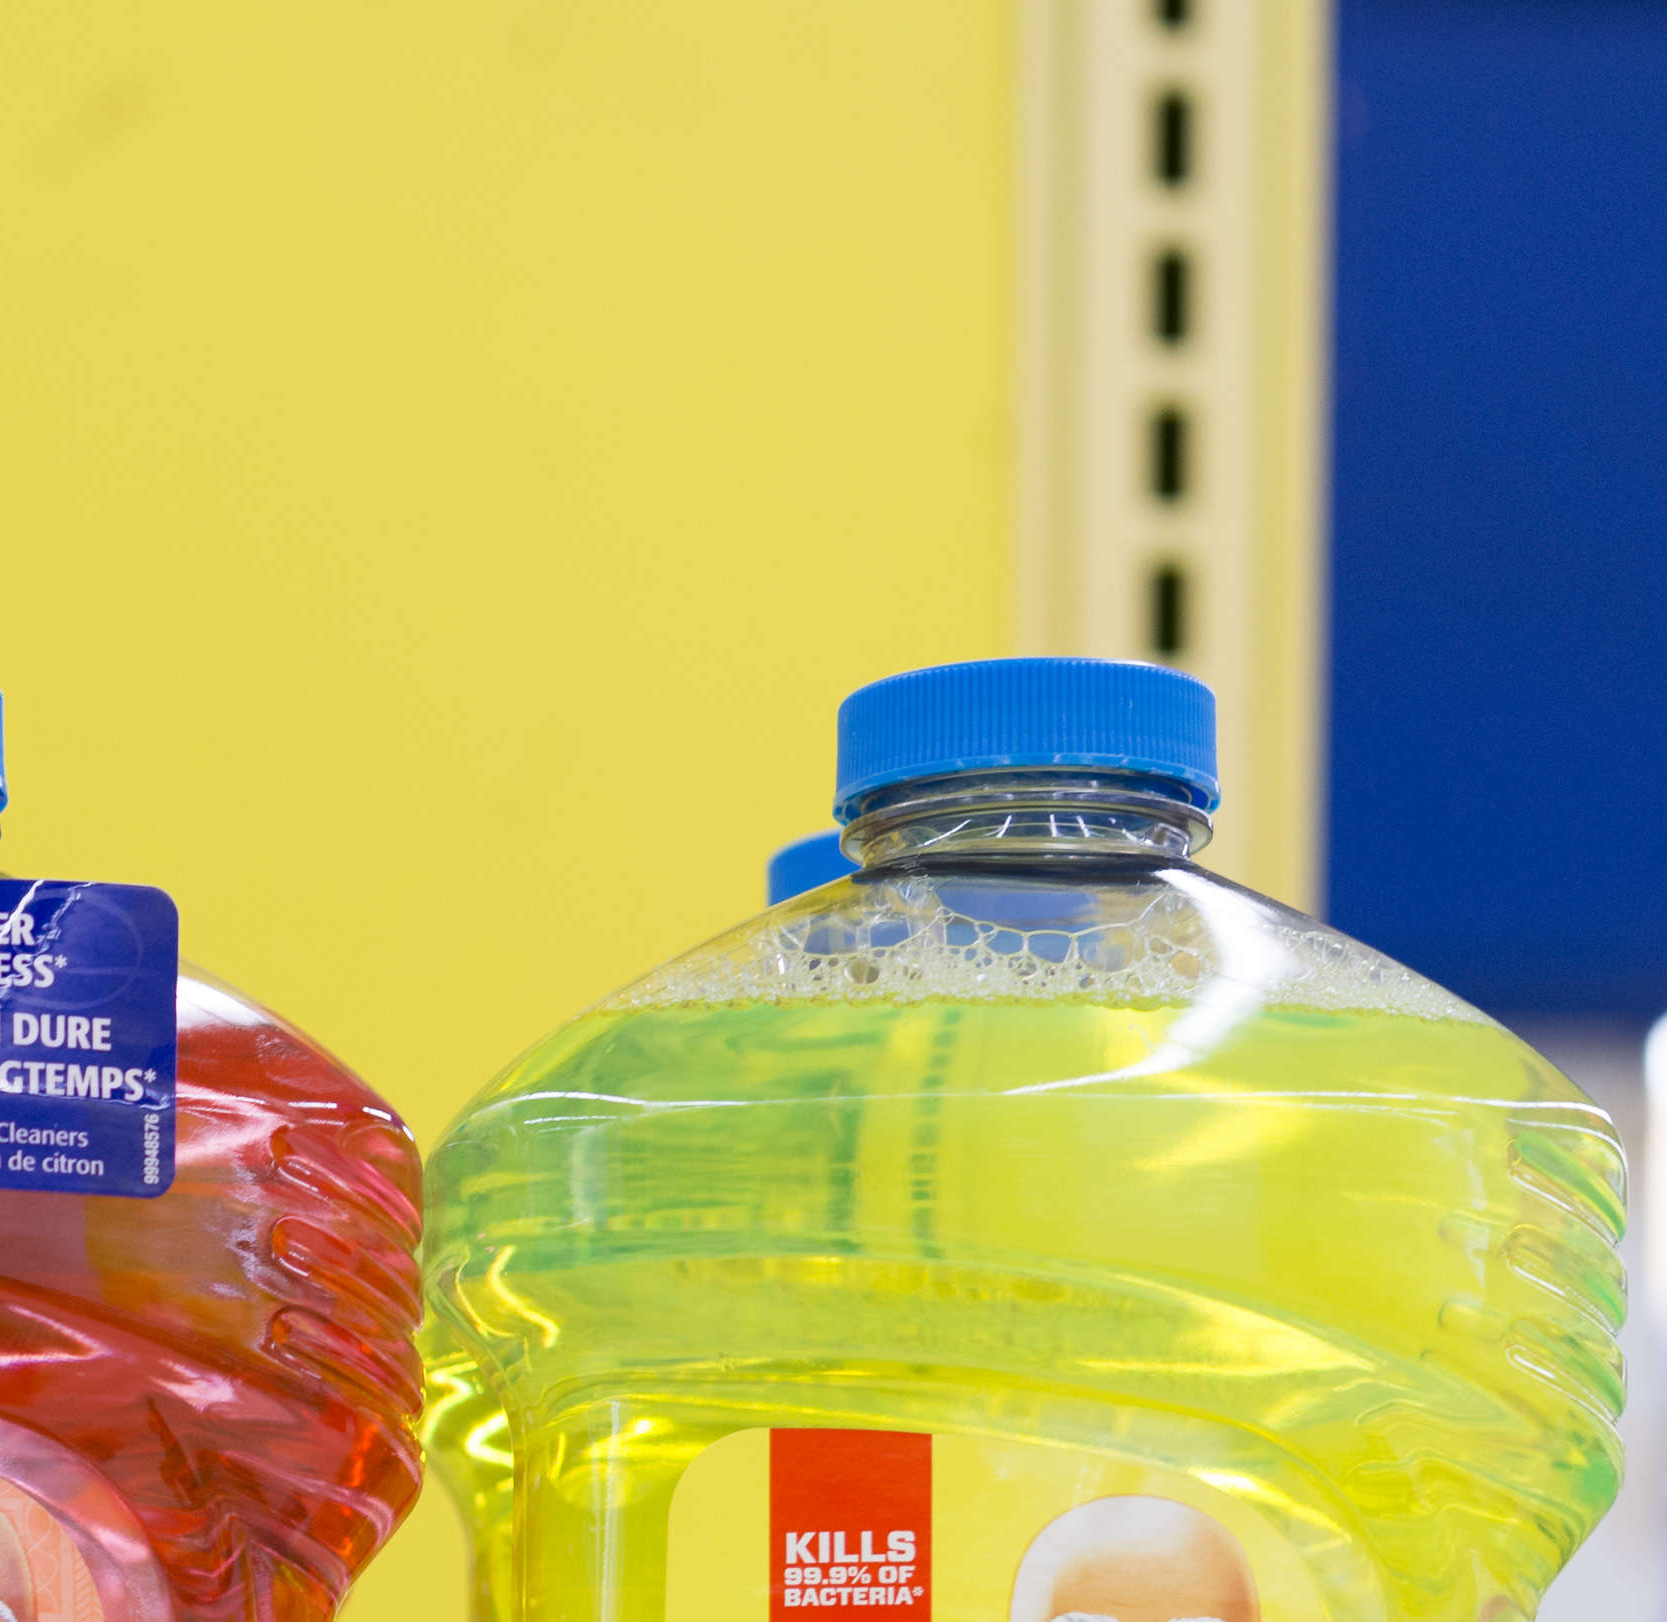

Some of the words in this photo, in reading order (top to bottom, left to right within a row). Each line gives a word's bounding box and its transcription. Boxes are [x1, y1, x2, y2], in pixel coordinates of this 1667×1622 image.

[13, 1014, 112, 1052] DURE
[7, 1150, 37, 1170] de
[41, 1151, 104, 1176] citron
[143, 1113, 160, 1185] 99948576
[785, 1530, 916, 1564] KILLS
[784, 1566, 871, 1585] 99.9%
[878, 1566, 916, 1584] OF
